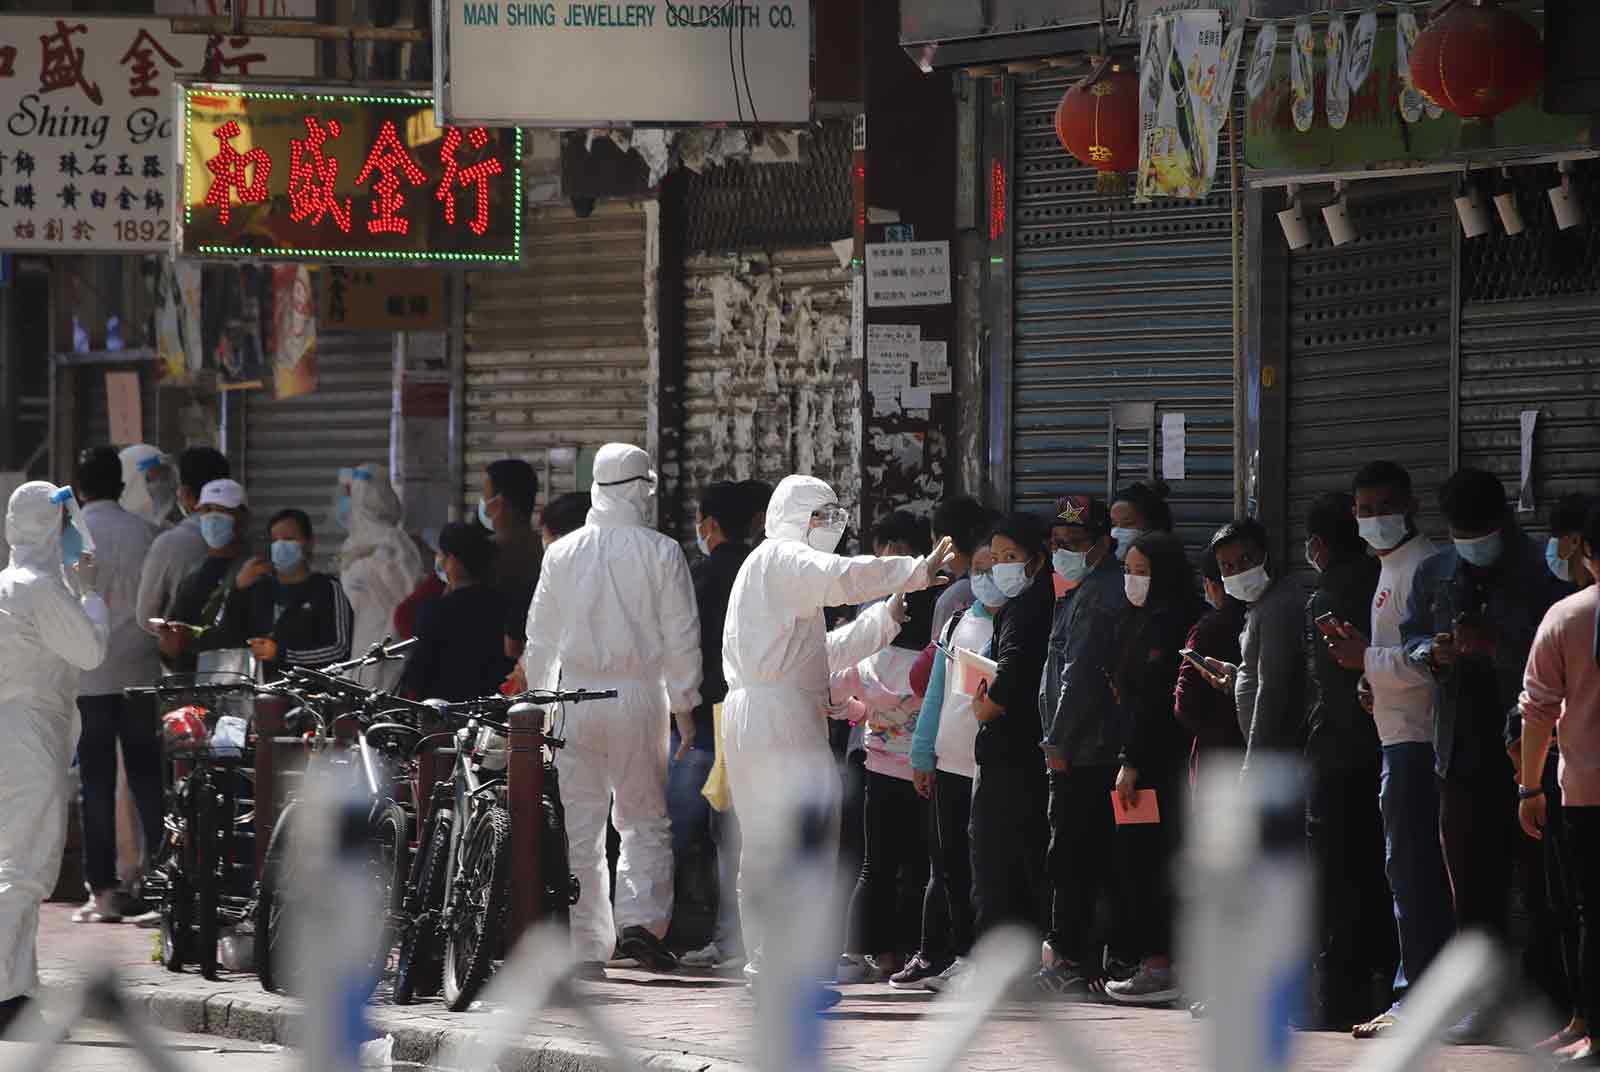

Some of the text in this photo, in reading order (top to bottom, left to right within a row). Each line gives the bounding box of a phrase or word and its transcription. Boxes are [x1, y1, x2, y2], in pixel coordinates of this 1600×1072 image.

[464, 2, 795, 29] MAN SHING JEWELLERY GOLDSMITH CO.
[7, 93, 109, 150] Shing
[205, 115, 503, 236] 和盛金行
[113, 219, 171, 242] 1892
